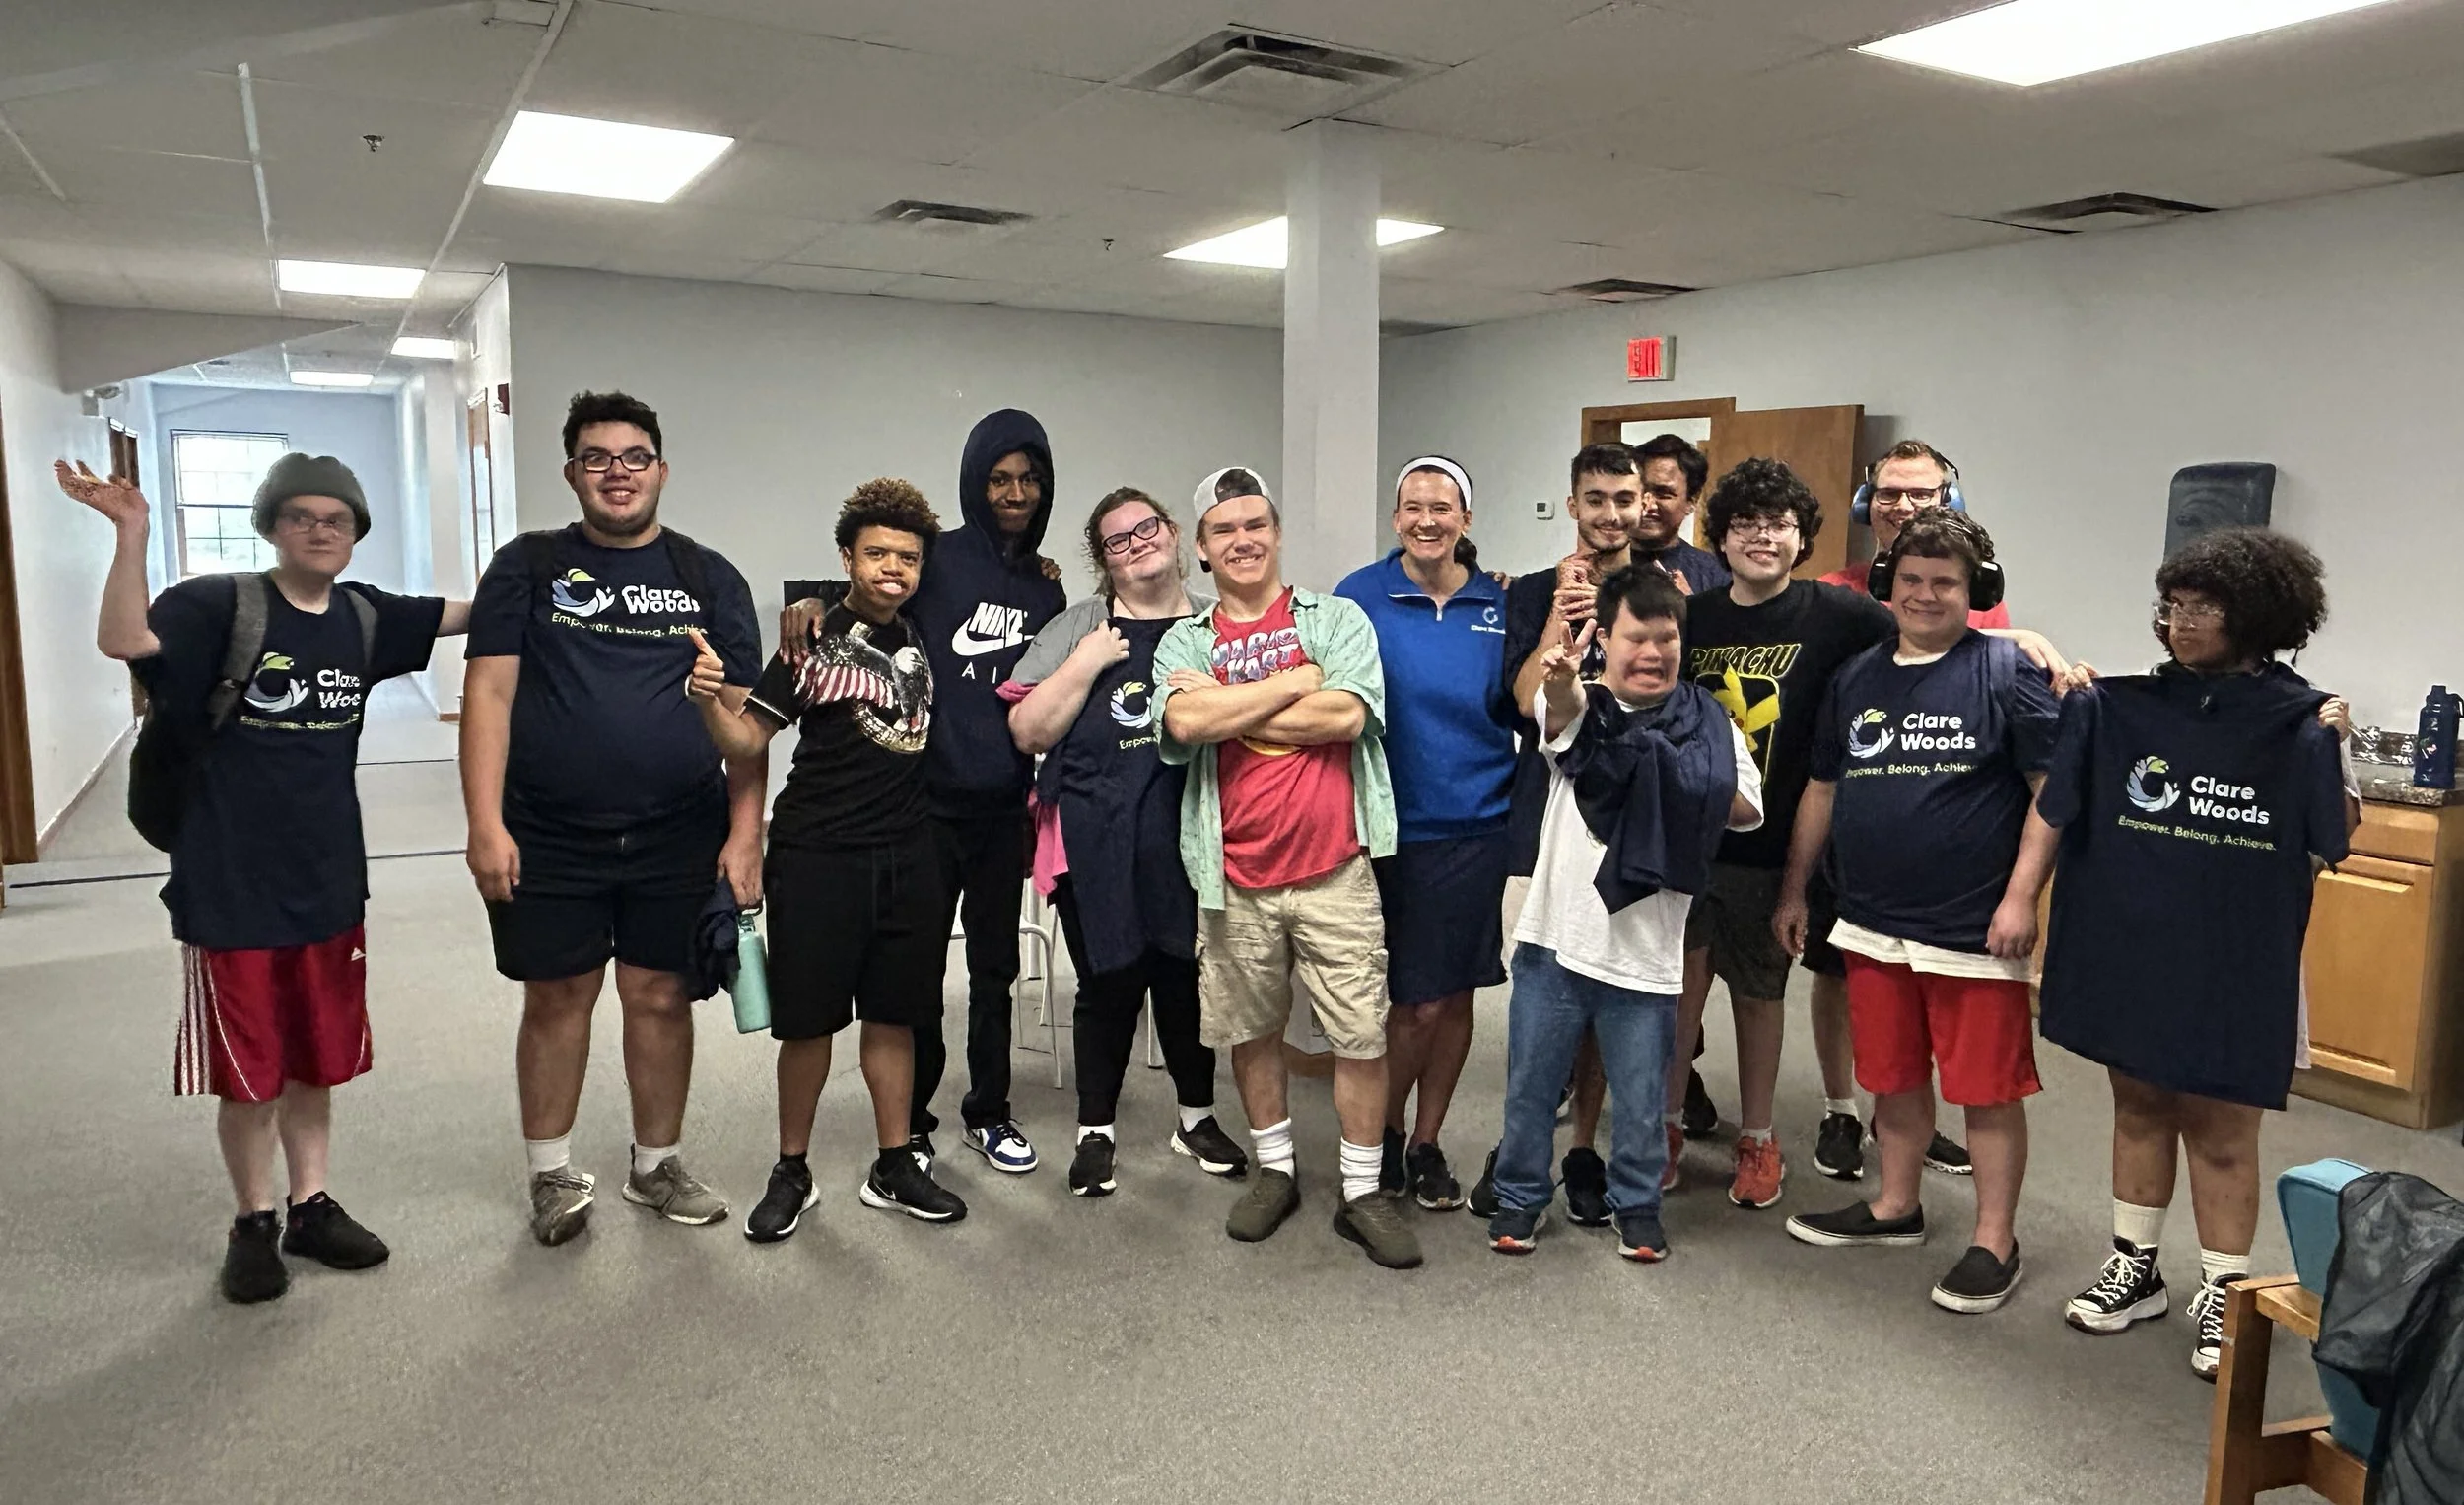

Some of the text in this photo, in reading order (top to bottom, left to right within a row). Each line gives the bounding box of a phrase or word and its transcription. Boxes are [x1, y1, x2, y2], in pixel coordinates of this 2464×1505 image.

[967, 602, 1028, 643] NIKE
[961, 661, 998, 684] AI
[1689, 643, 1802, 680] PIKACHU
[1902, 712, 1963, 730] Clare
[1900, 731, 1977, 751] Woods
[1887, 763, 1931, 777] Belong.
[2190, 776, 2256, 800] Clare
[2188, 796, 2271, 825] Woods
[2174, 826, 2220, 844] Belong.
